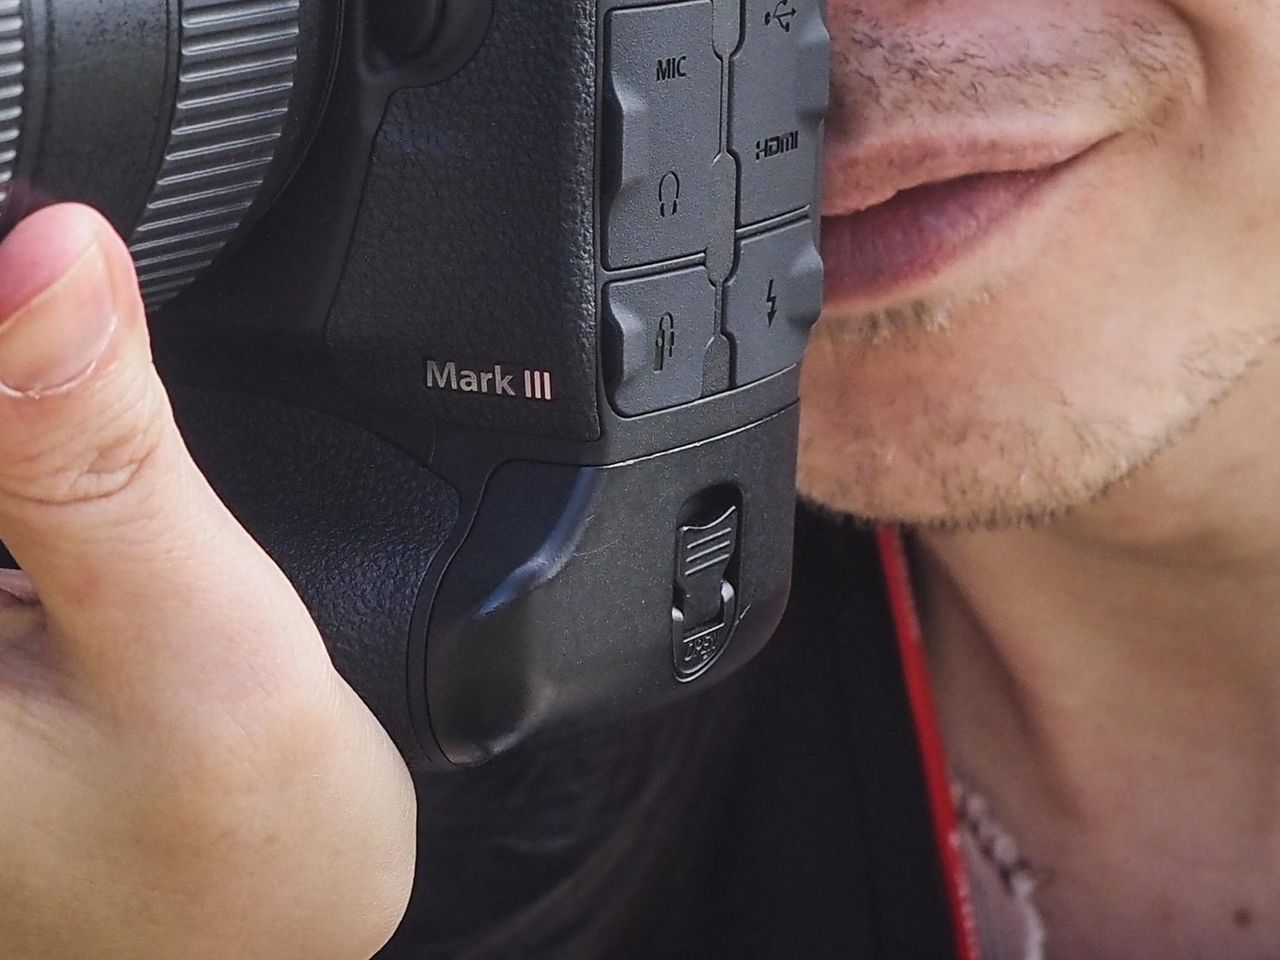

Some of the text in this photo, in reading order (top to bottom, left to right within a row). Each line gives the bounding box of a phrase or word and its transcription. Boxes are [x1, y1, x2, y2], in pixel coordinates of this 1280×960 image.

[655, 55, 687, 83] MIC
[754, 129, 799, 161] HDMI
[425, 359, 552, 401] Mark III
